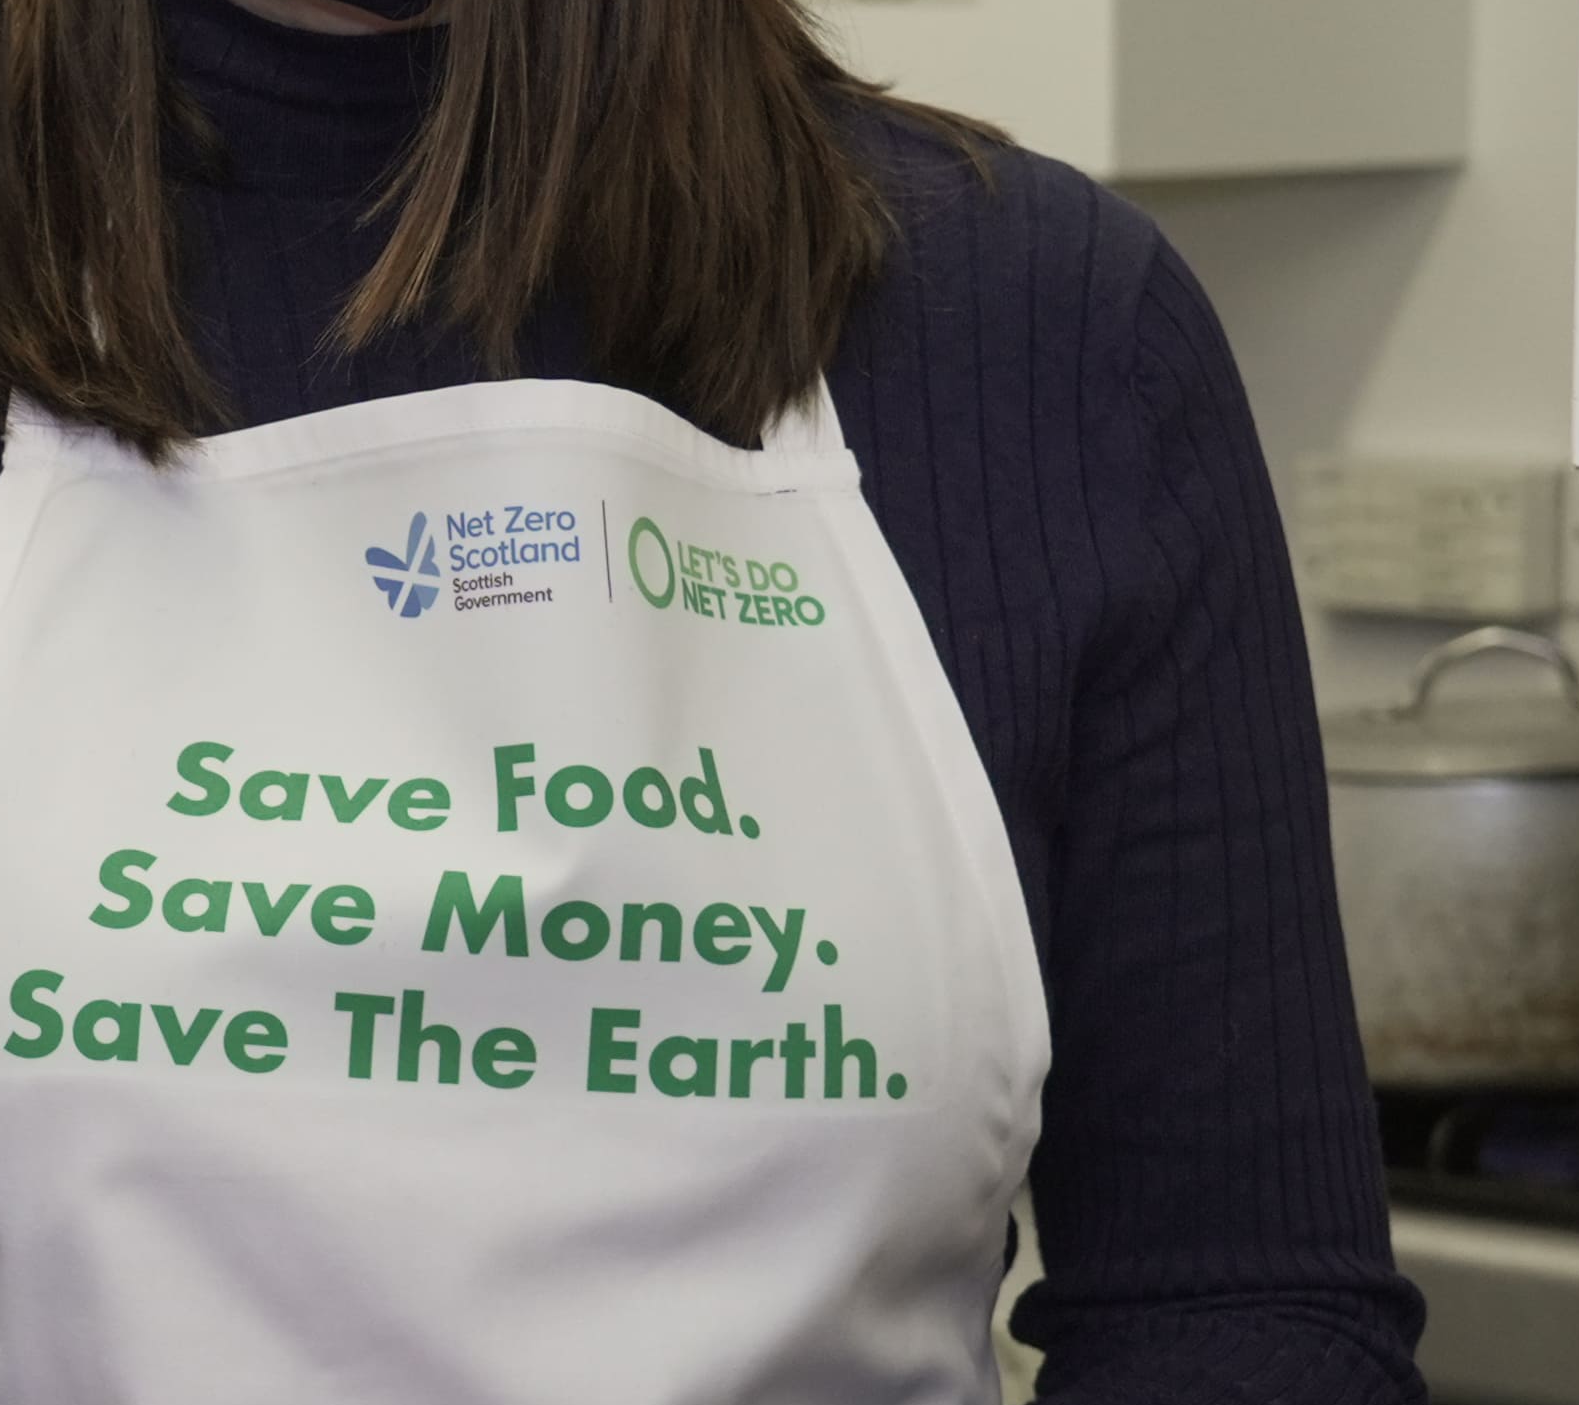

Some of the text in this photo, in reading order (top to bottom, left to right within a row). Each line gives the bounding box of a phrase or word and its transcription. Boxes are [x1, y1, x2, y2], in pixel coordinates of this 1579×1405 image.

[446, 505, 576, 541] Net Zero
[448, 536, 581, 572] Scotland
[677, 539, 799, 592] LET'S DO
[451, 571, 514, 594] Scottish
[453, 586, 553, 611] Government
[682, 577, 826, 626] NET ZERO
[164, 740, 762, 840] Save Food.
[87, 848, 839, 993] Save Money.
[2, 968, 908, 1100] Save The Earth.
